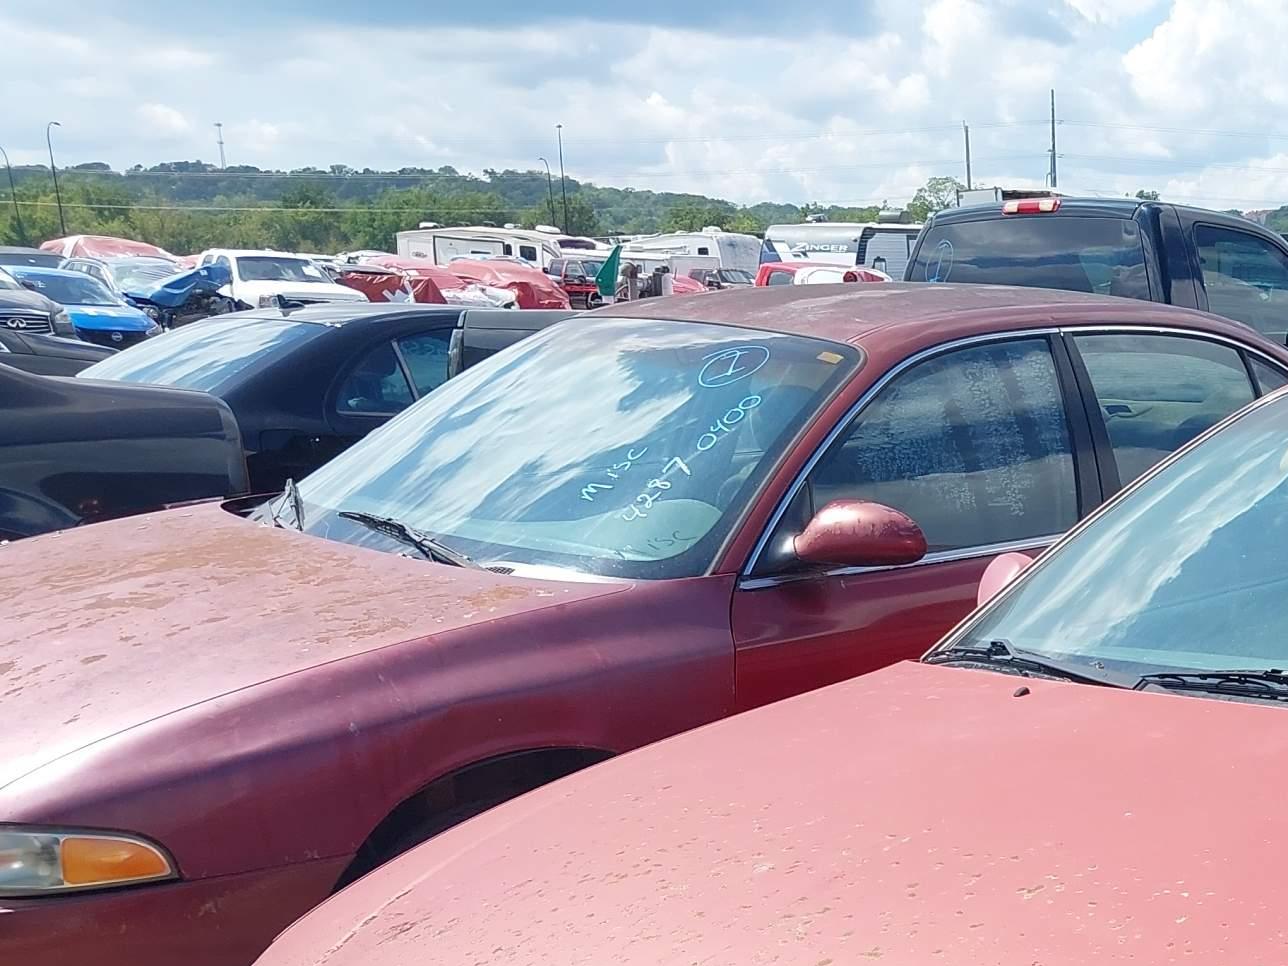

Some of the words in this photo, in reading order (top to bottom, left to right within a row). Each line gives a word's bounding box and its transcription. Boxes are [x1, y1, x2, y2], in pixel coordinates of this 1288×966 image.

[790, 242, 849, 253] ZINGER
[622, 456, 692, 522] 4287
[696, 395, 762, 451] 0400
